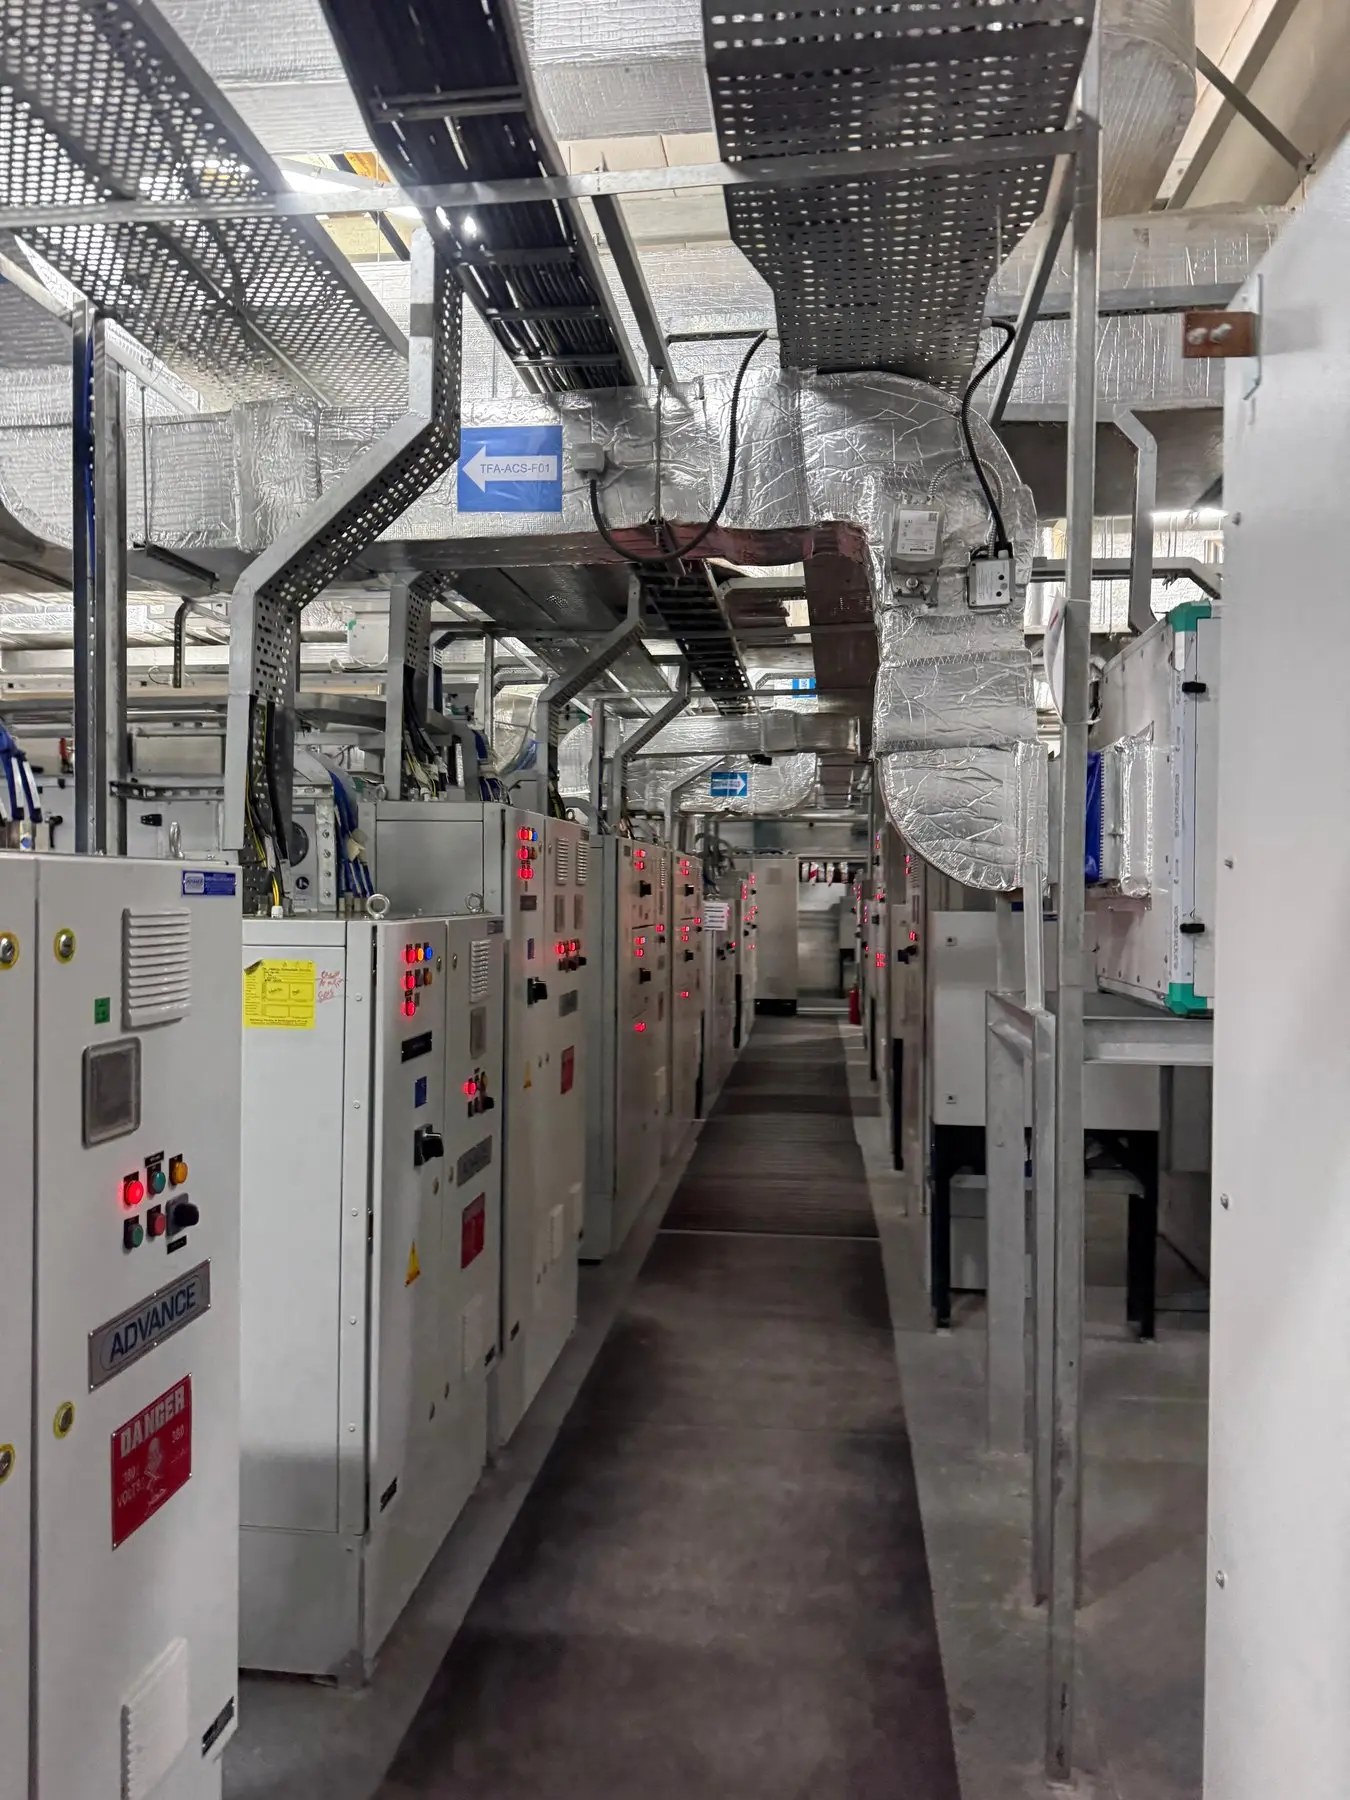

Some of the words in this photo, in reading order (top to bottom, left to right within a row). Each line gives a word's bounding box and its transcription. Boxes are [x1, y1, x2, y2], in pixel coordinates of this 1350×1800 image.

[480, 463, 550, 473] TFA-ACS-F01
[110, 1282, 196, 1362] ADVANCE
[120, 1385, 185, 1457] DANGER
